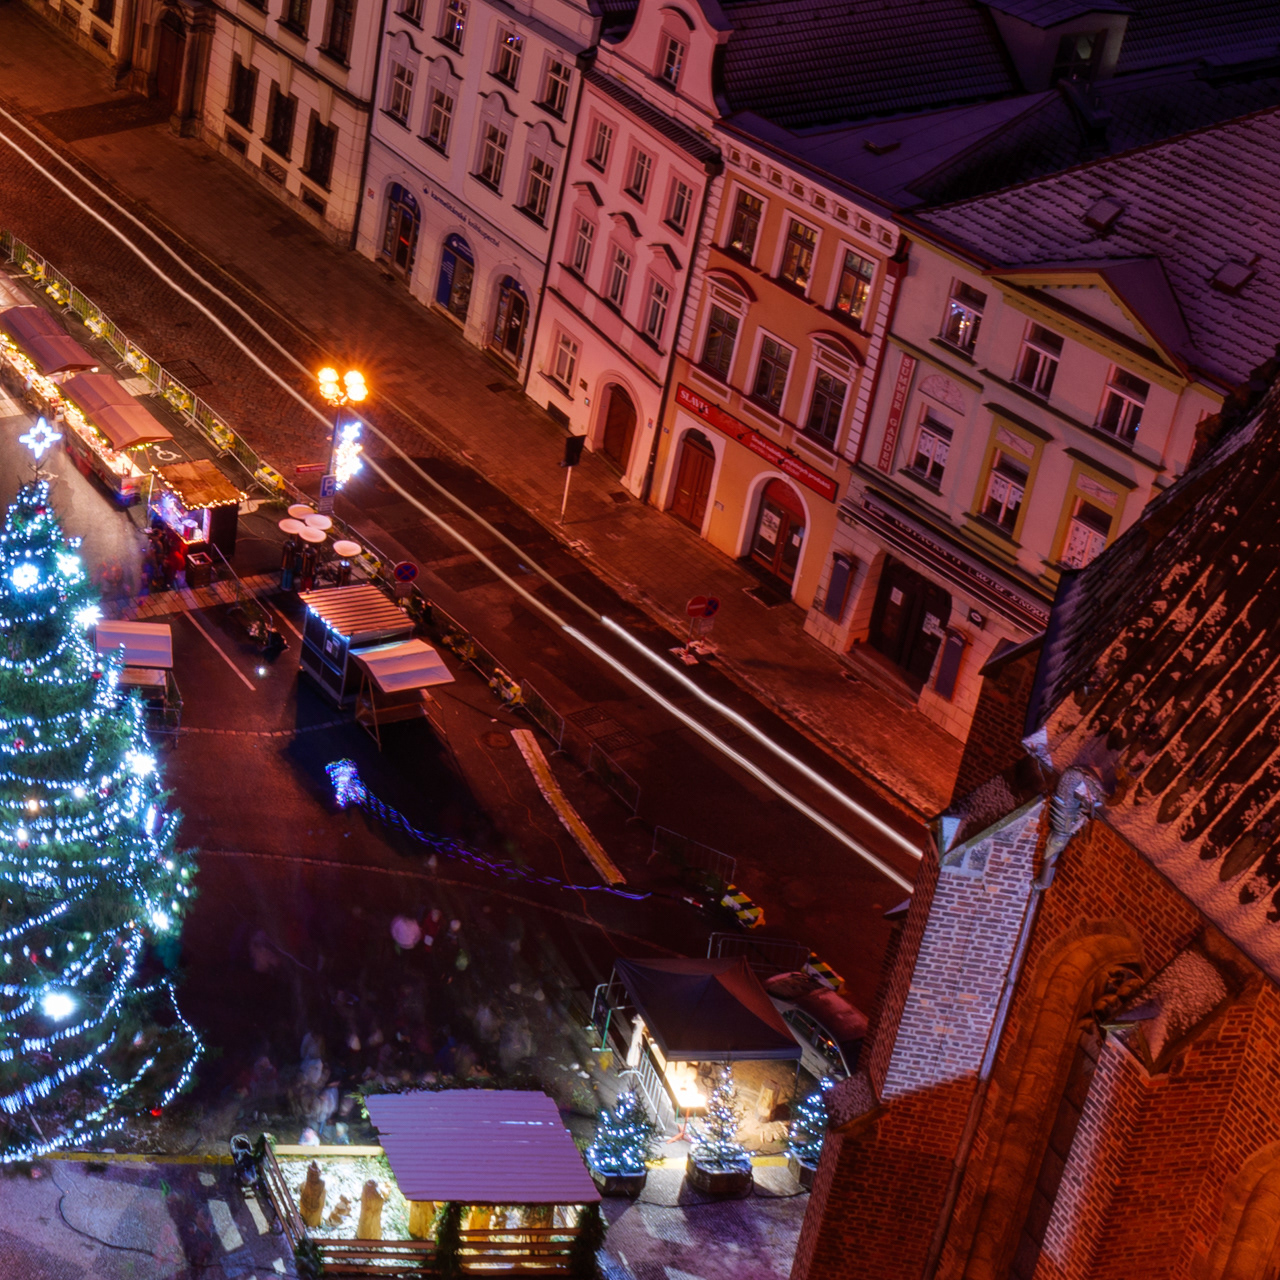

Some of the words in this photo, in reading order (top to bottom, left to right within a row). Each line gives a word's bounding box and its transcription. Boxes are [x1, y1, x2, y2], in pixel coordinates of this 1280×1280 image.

[680, 389, 710, 416] SLAVIA
[893, 358, 911, 411] SUMMER
[879, 418, 898, 470] GARDEN
[324, 478, 334, 492] P
